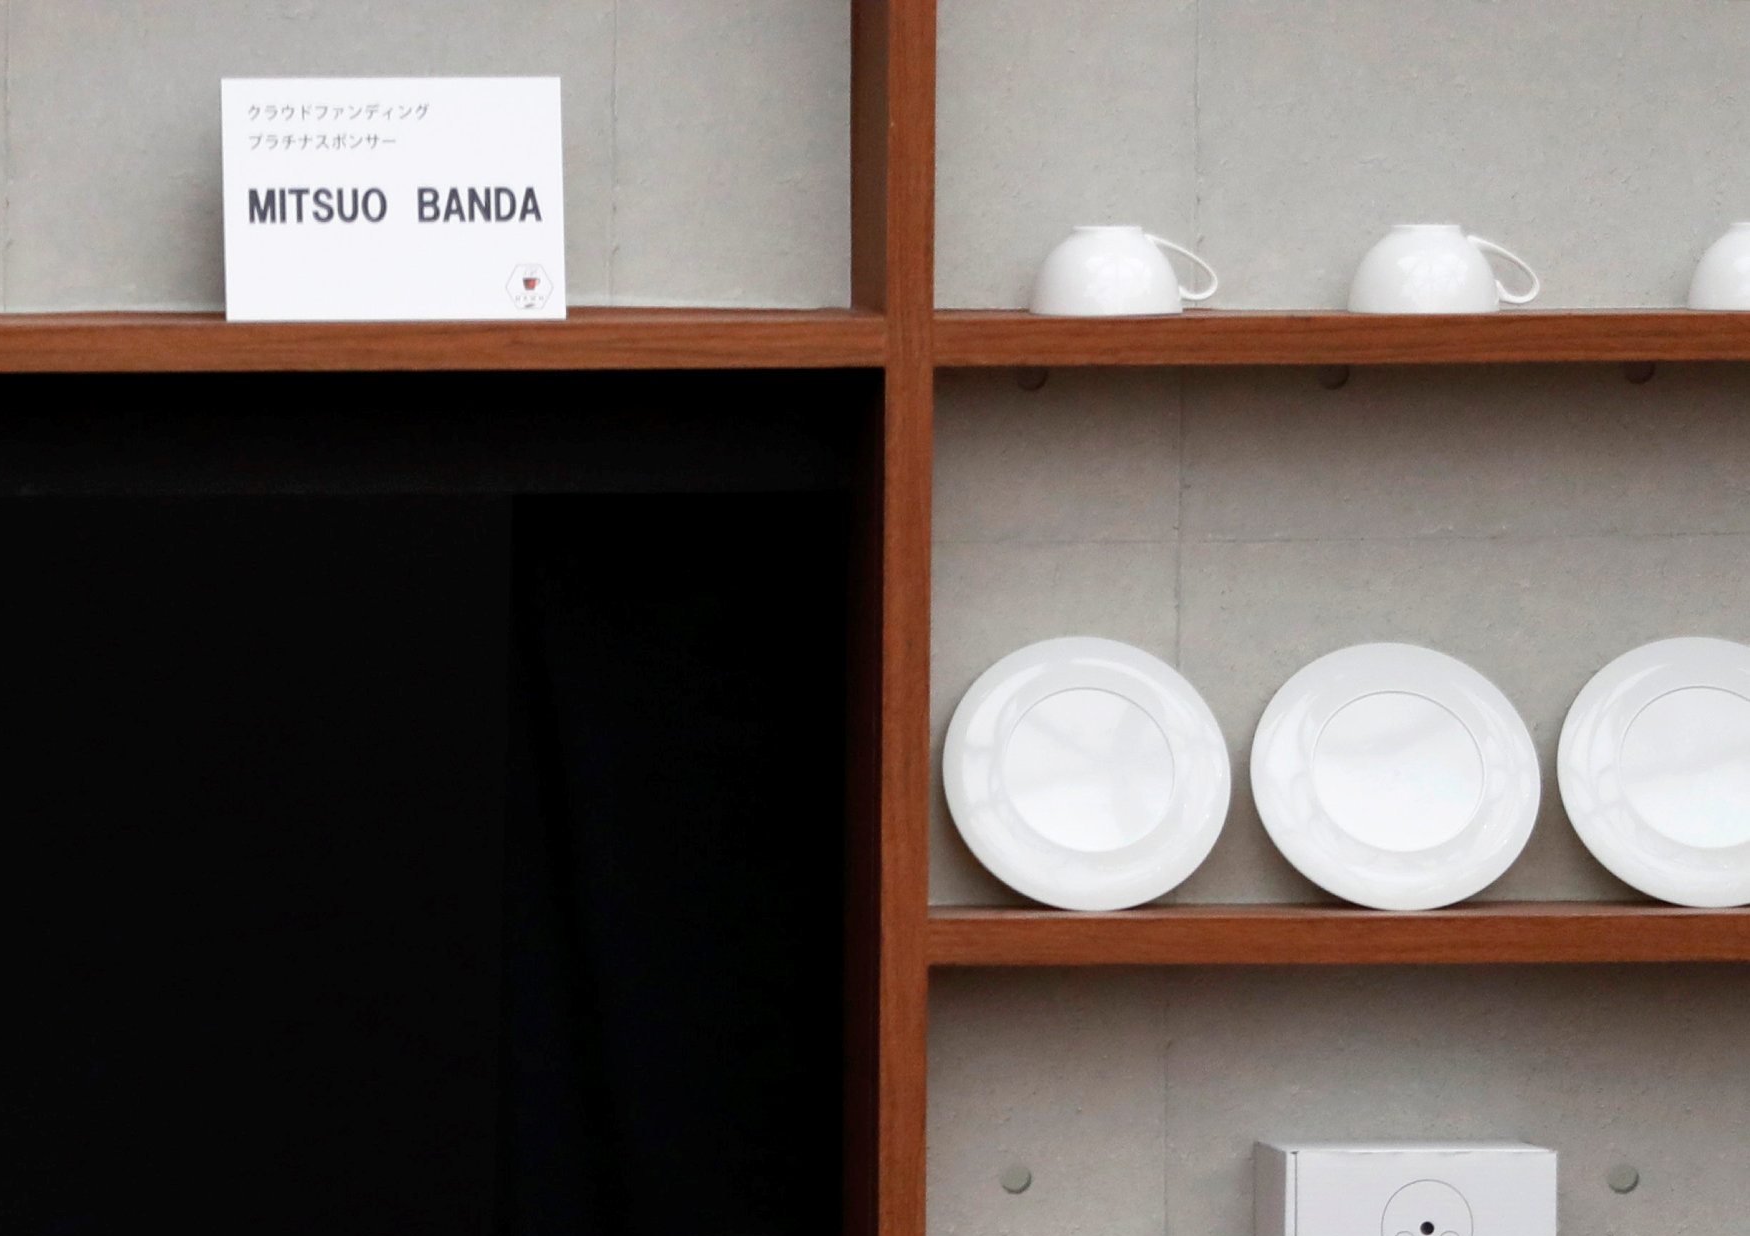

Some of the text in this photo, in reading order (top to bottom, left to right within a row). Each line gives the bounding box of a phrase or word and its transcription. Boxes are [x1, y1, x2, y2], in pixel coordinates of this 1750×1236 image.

[247, 103, 430, 121] クラウドファンディング
[248, 133, 397, 150] プラチナスポンサー
[248, 186, 543, 224] MITSUO BANDA
